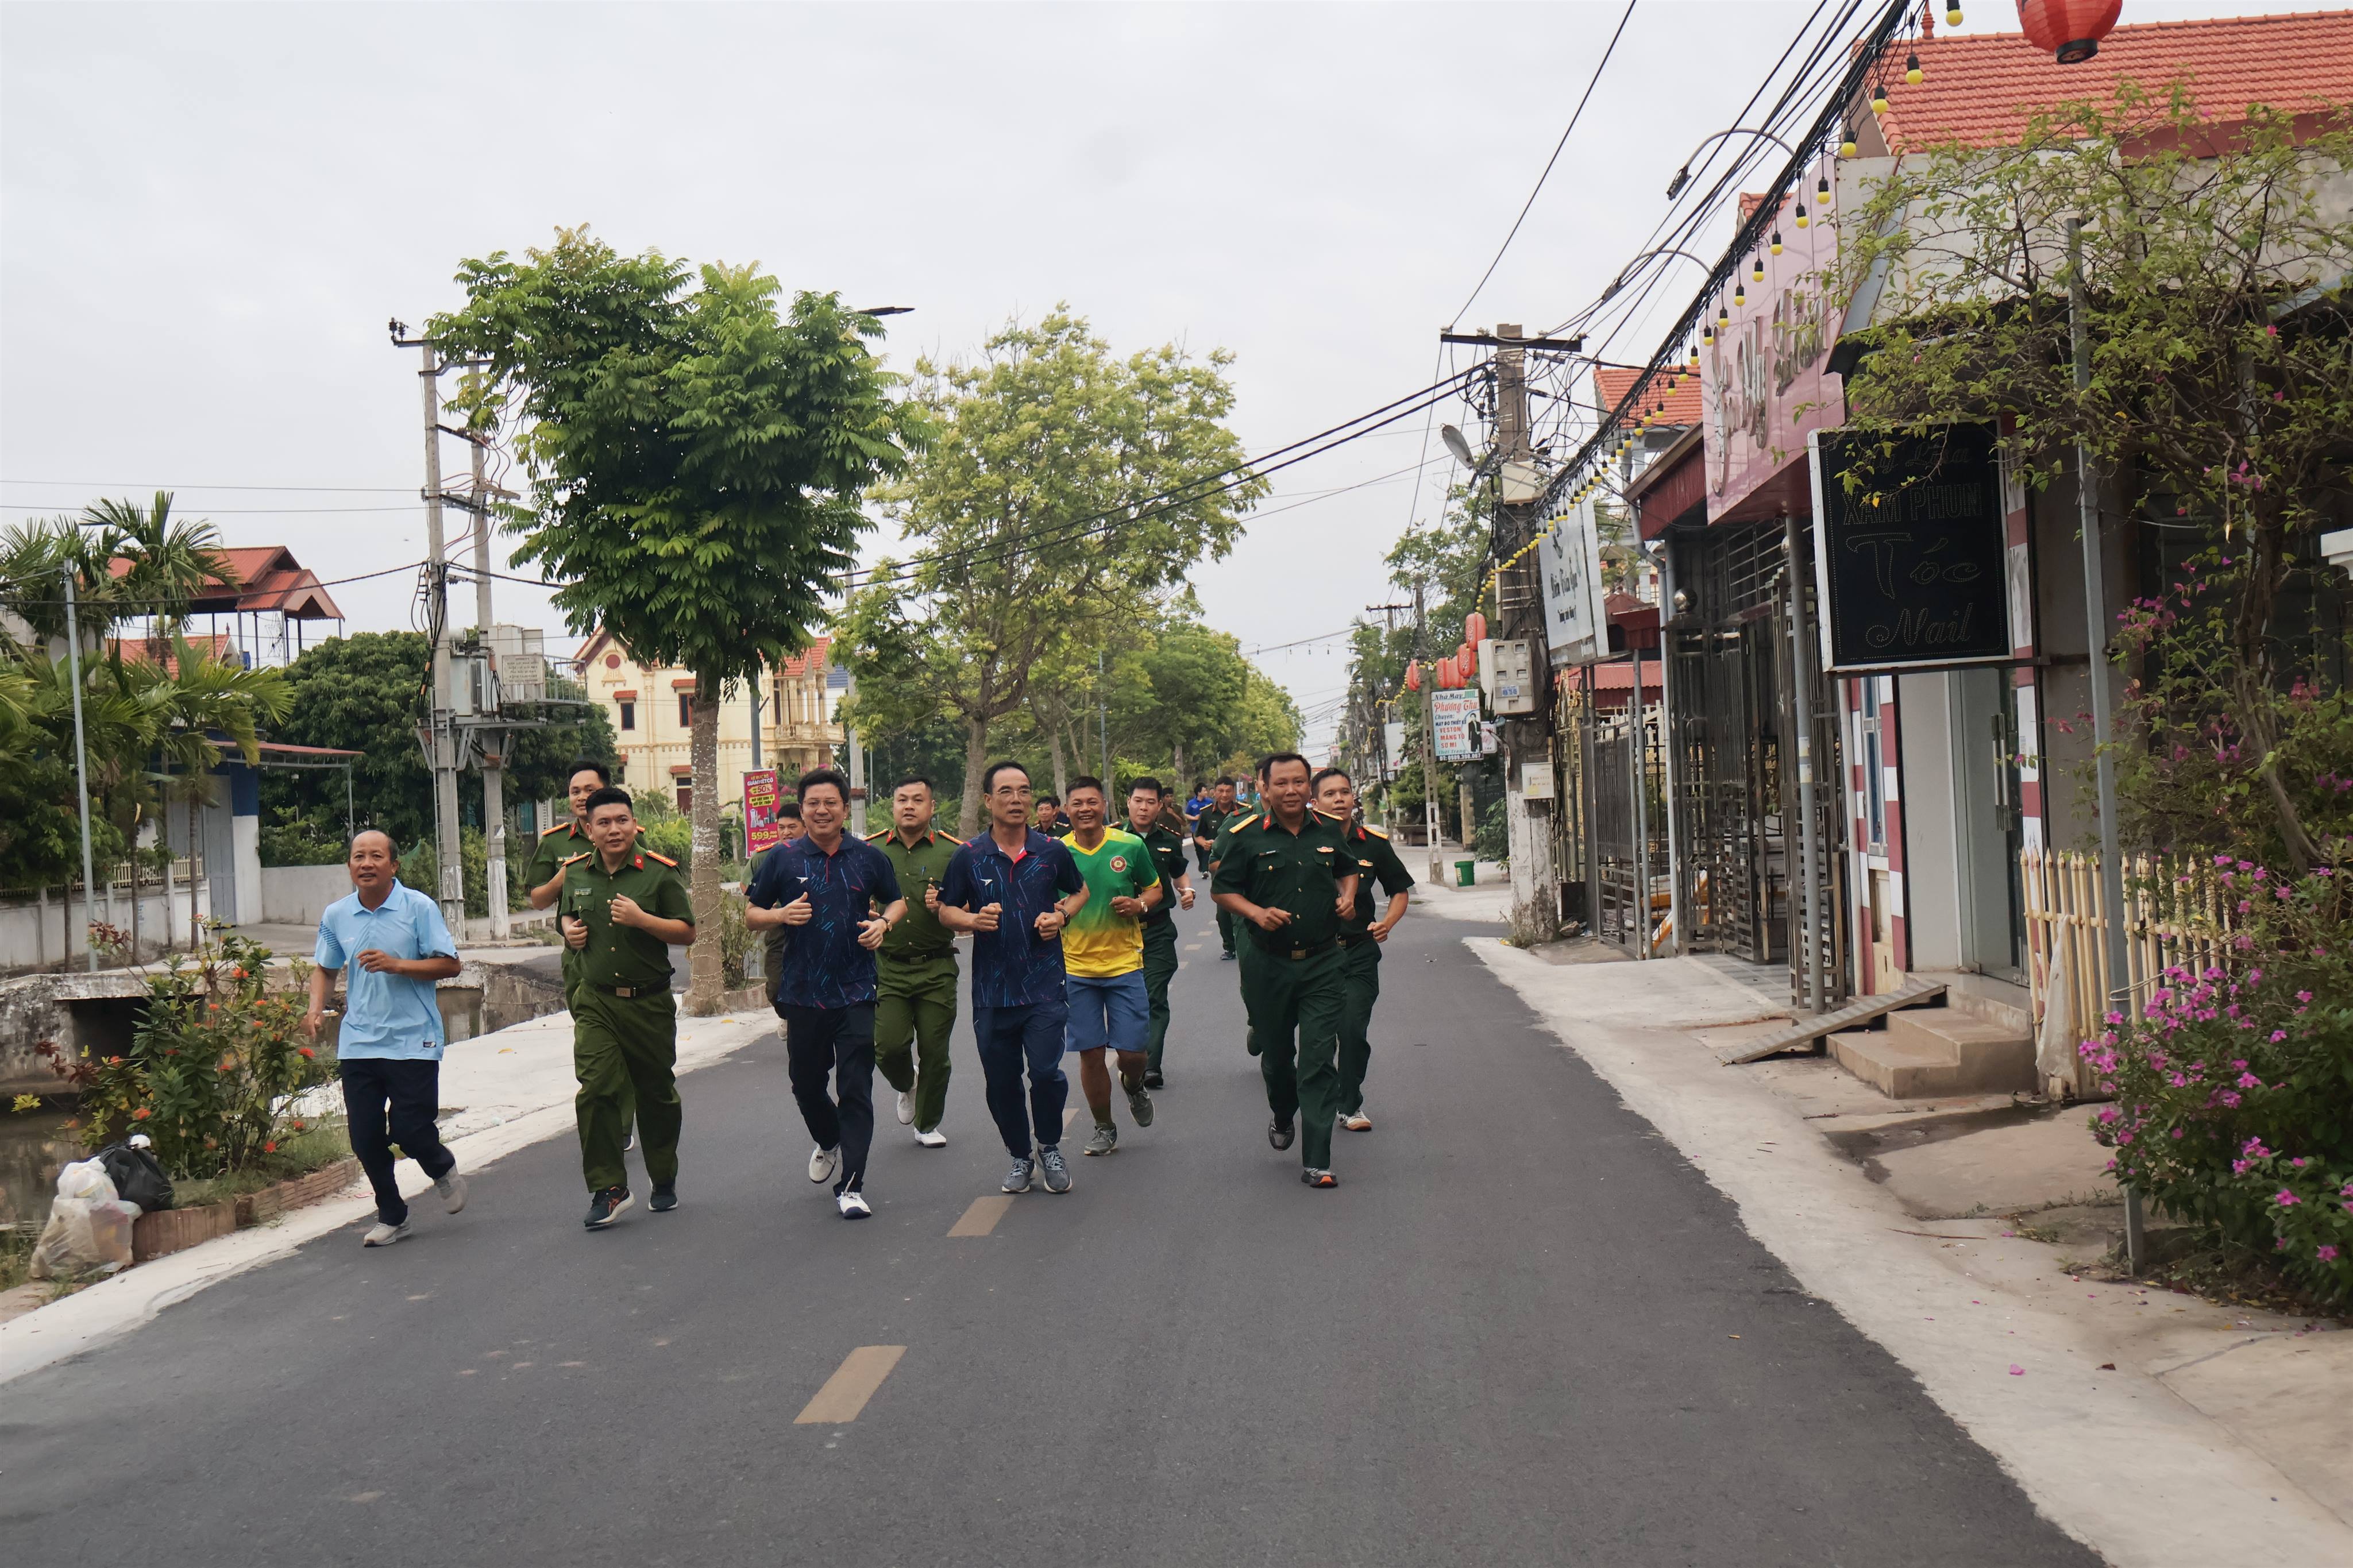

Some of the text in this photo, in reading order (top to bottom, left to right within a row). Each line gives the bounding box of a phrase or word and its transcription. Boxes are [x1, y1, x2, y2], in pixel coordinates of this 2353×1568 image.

[1909, 482, 1984, 521] PHUN
[1845, 532, 1982, 600] Tóc
[1865, 603, 1974, 648] Nail
[1434, 700, 1478, 713] Phương Thu
